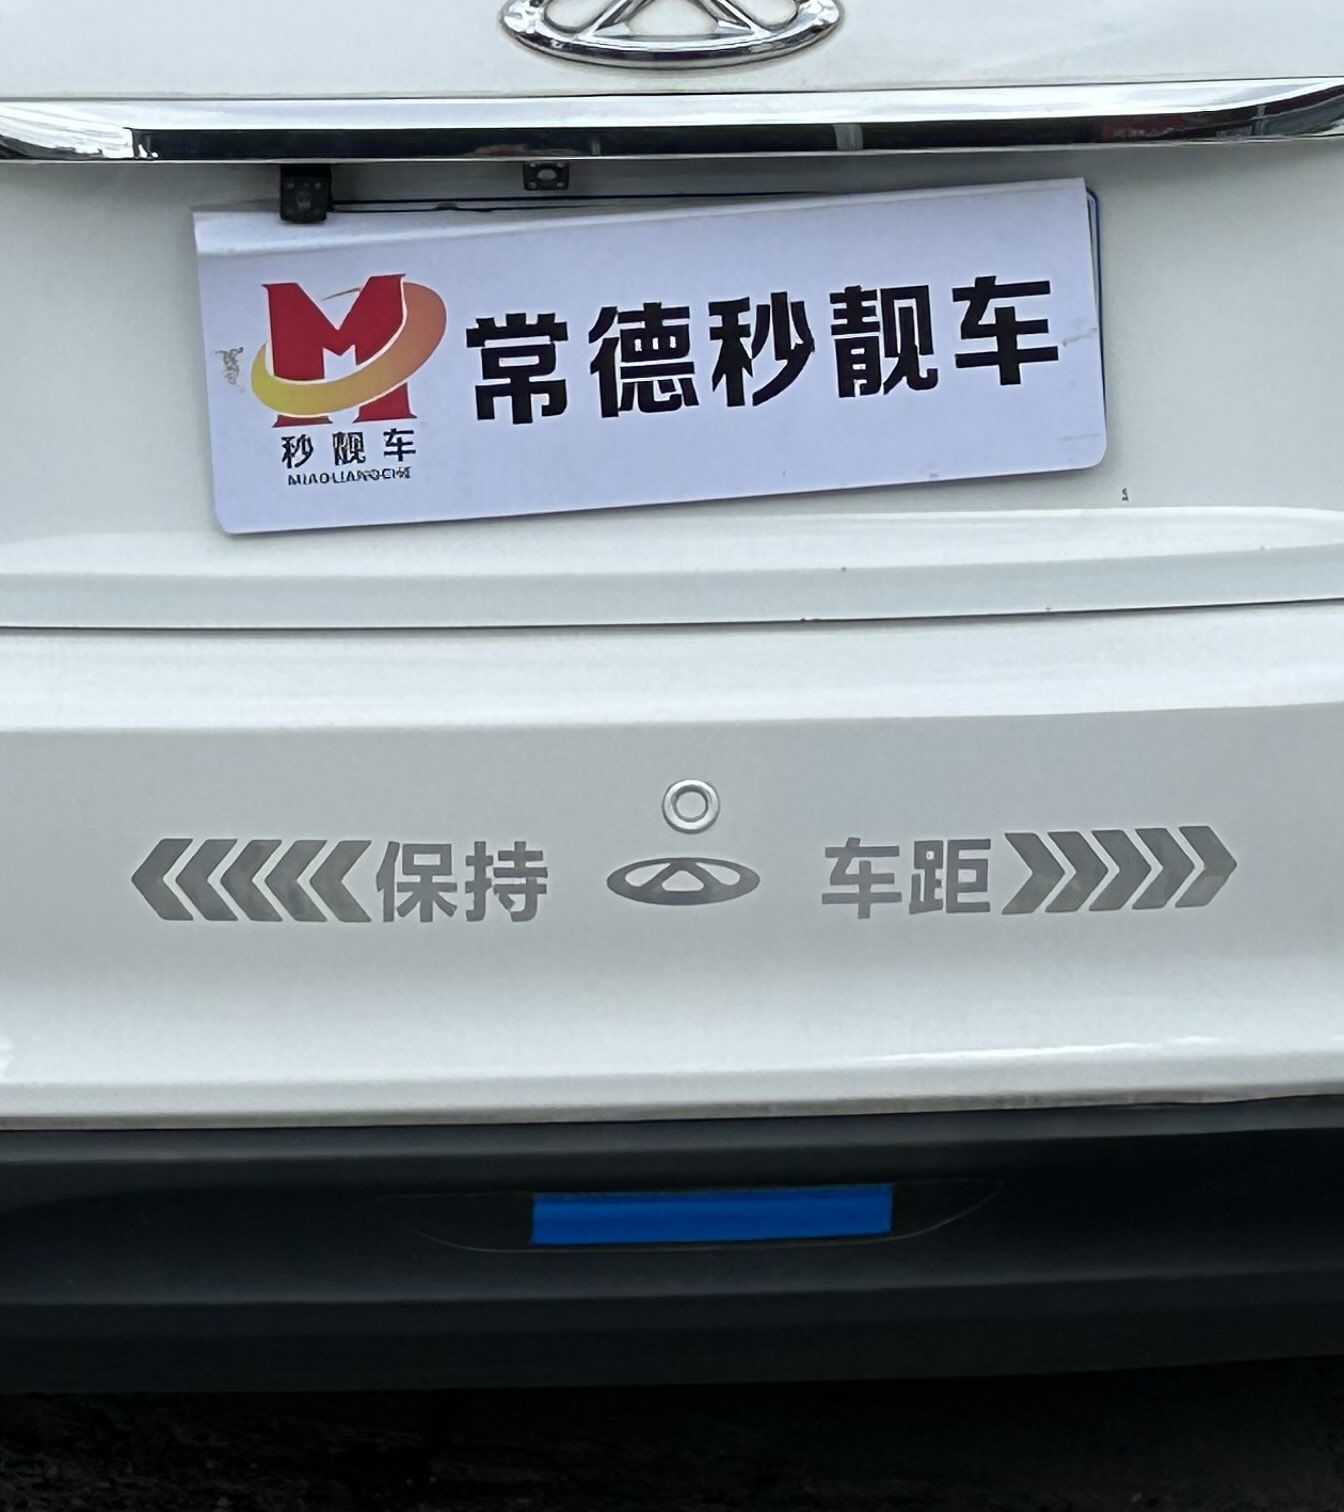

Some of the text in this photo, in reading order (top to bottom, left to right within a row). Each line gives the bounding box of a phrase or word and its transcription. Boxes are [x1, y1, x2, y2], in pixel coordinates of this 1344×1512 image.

[465, 275, 1059, 425] 常德秒靓车
[281, 427, 416, 469] 秒靓车
[376, 836, 992, 923] 保持 车距
